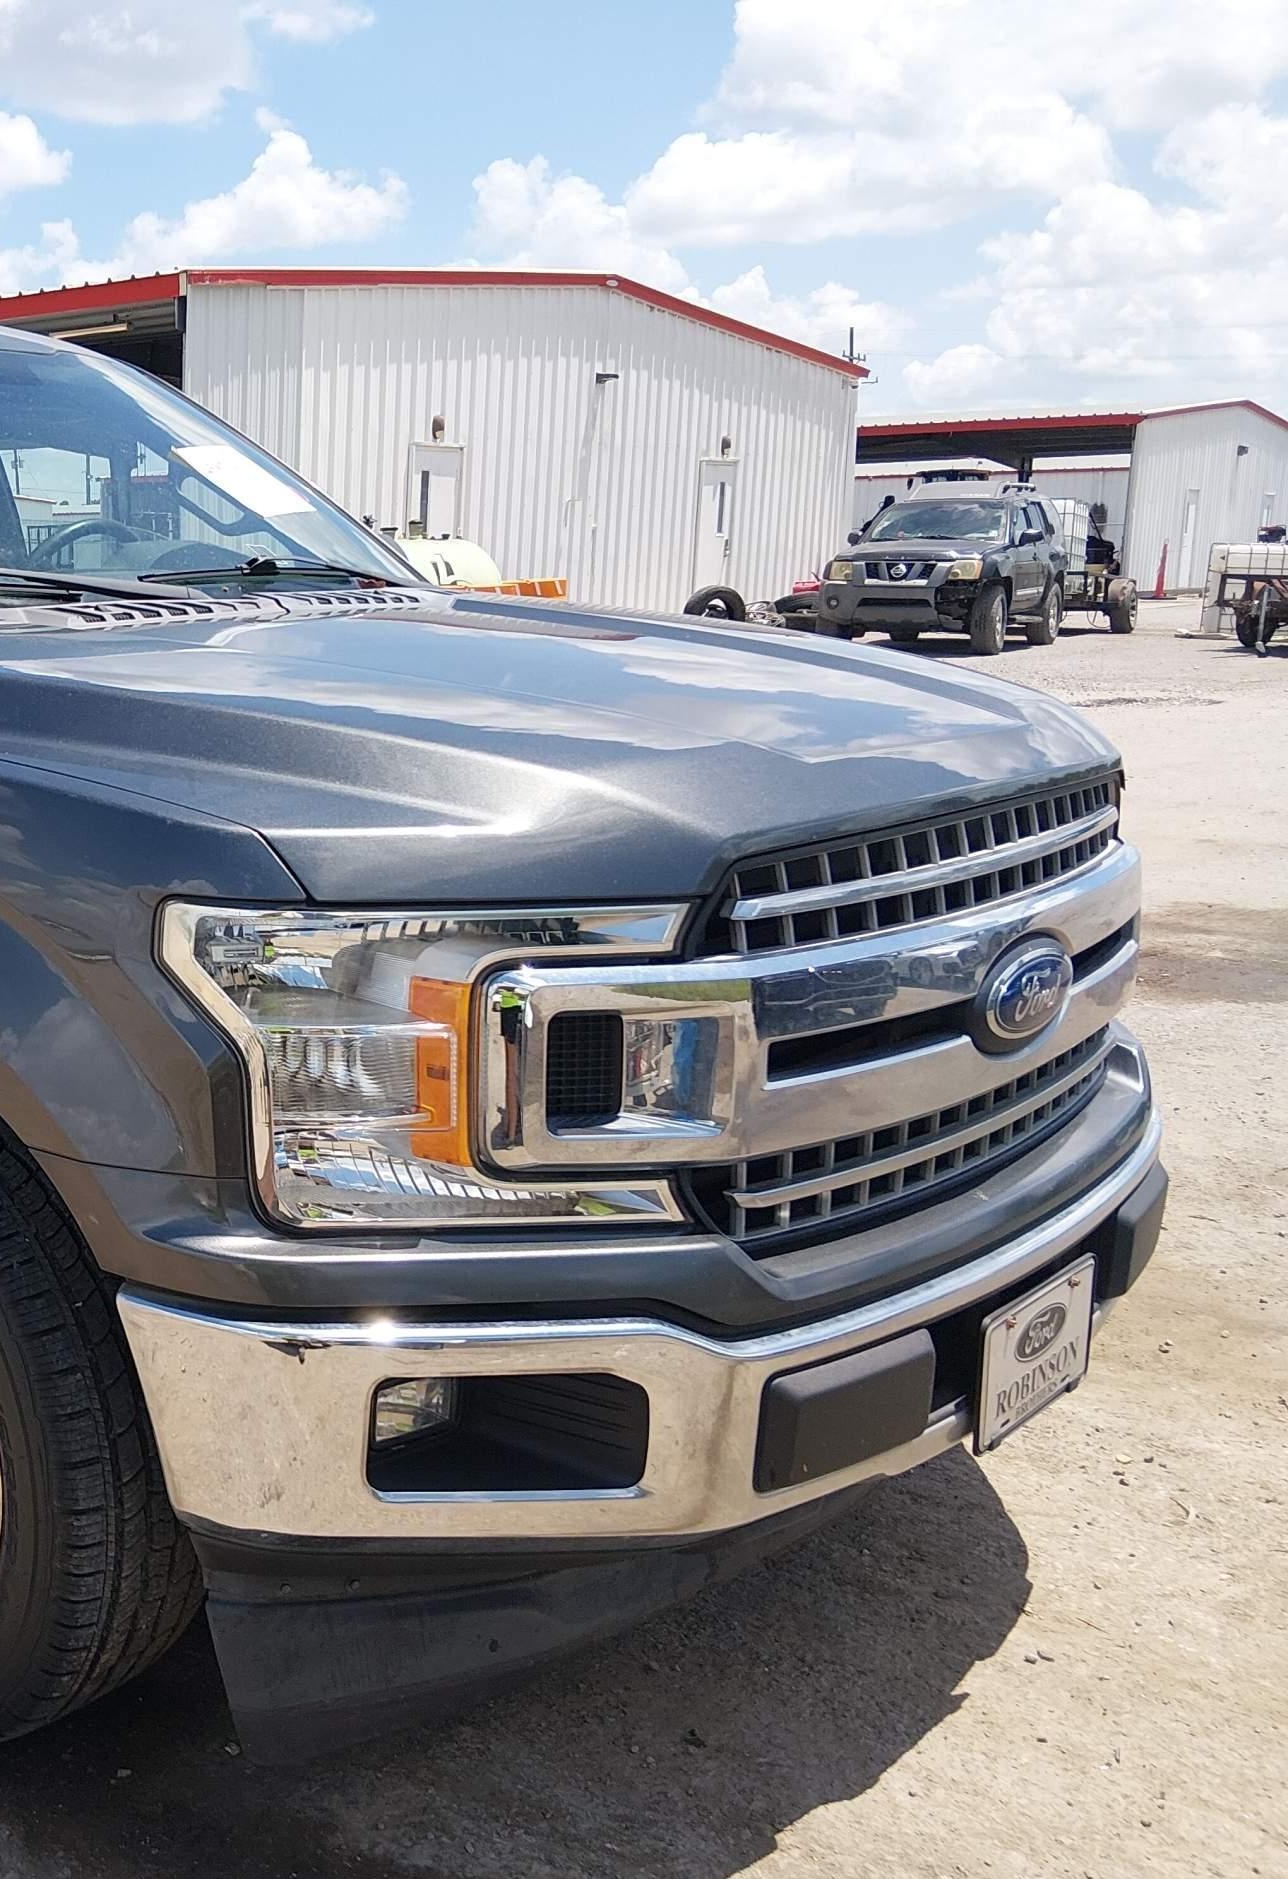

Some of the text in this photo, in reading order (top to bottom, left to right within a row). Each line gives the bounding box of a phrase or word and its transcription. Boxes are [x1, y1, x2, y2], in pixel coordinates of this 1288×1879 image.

[1015, 967, 1060, 1022] Ford
[1024, 1311, 1059, 1354] Ford
[995, 1337, 1080, 1418] ROBINSON
